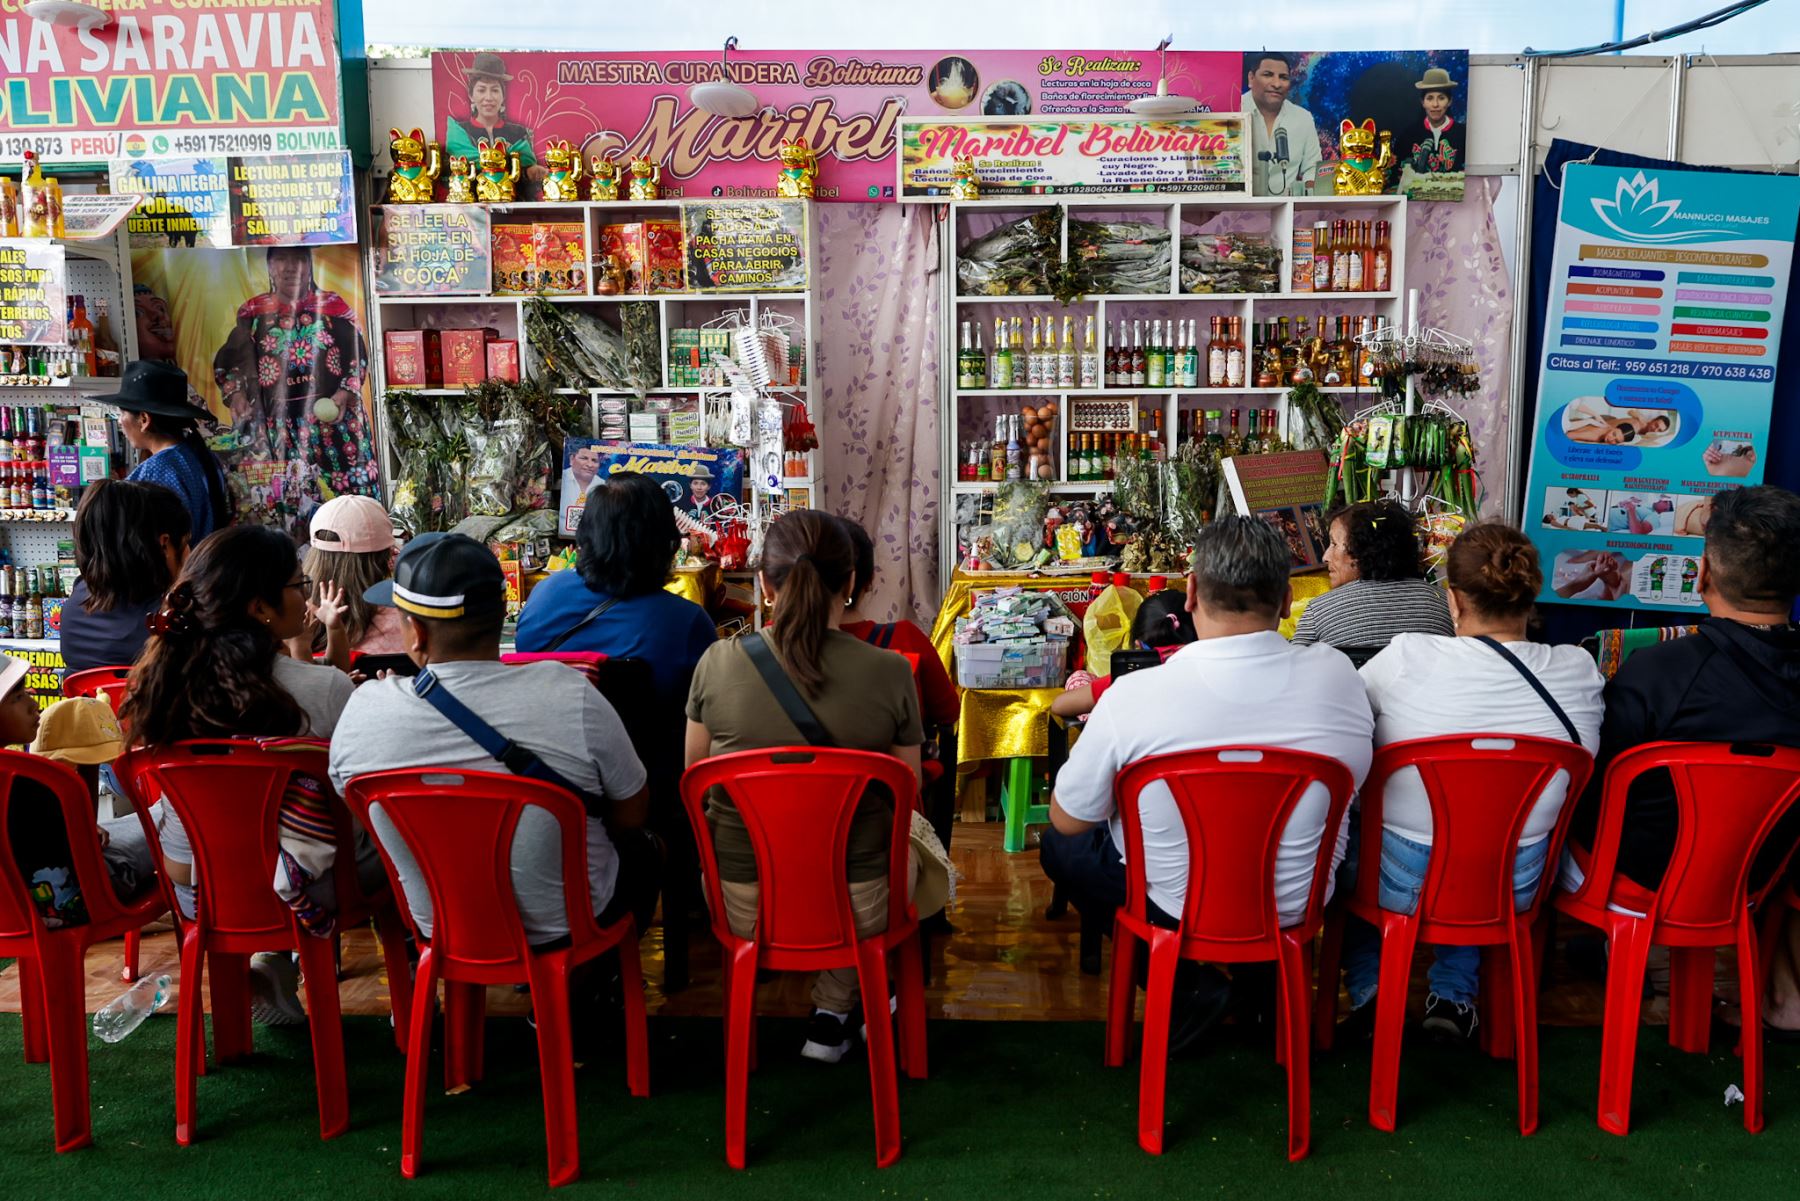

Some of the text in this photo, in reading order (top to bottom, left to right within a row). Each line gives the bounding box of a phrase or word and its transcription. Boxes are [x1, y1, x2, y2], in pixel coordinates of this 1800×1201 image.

[77, 11, 326, 72] SARAVIA
[559, 56, 923, 88] MAESTRA CURANDERA Boliviana
[1038, 56, 1142, 76] Se Realizan:
[1041, 79, 1078, 87] Lecturas
[1100, 79, 1119, 90] hoja
[1120, 79, 1131, 88] de
[0, 71, 331, 127] LIVIANA
[1041, 92, 1067, 101] Baños
[1067, 92, 1080, 101] de
[1080, 92, 1136, 101] florecimiento
[1041, 104, 1081, 113] Ofrendas
[1089, 104, 1098, 113] la
[1098, 104, 1123, 113] Santa
[35, 136, 62, 155] 873
[71, 132, 116, 155] PERÚ
[276, 131, 338, 152] BOLIVIA
[581, 96, 908, 180] Maribel
[919, 123, 1230, 159] Maribel Boliviana
[233, 161, 343, 181] LECTURA DE COCA
[978, 160, 1033, 168] Se Realizan
[982, 175, 1006, 183] hoja
[1216, 169, 1241, 177] para
[117, 173, 228, 194] GALLINA NEGRA
[248, 181, 332, 199] DESCUBRE TU
[727, 186, 777, 198] Bolivian
[136, 194, 214, 215] PODEROSA
[242, 201, 300, 217] DESTINO:
[390, 214, 468, 229] SE LEE LA
[706, 208, 782, 220] SE REALIZAN
[1673, 211, 1724, 223] MANNUCCI
[1725, 214, 1770, 225] MASAJES
[293, 217, 338, 234] DINERO
[387, 231, 472, 246] SUERTE EN
[696, 233, 795, 246] PACHA MAMA EN:
[387, 248, 474, 263] LA HOJA DE
[694, 246, 798, 259] CASAS NEGOCIOS
[712, 260, 744, 271] PARA
[24, 269, 54, 284] PARA
[1550, 356, 1580, 370] Citas
[1582, 358, 1593, 370] al
[1625, 360, 1647, 373] 959
[1648, 362, 1667, 374] 651
[1670, 363, 1690, 375] 218
[1701, 365, 1722, 377] 970
[1724, 366, 1746, 378] 638
[1748, 367, 1771, 380] 438
[608, 455, 698, 476] Maribel
